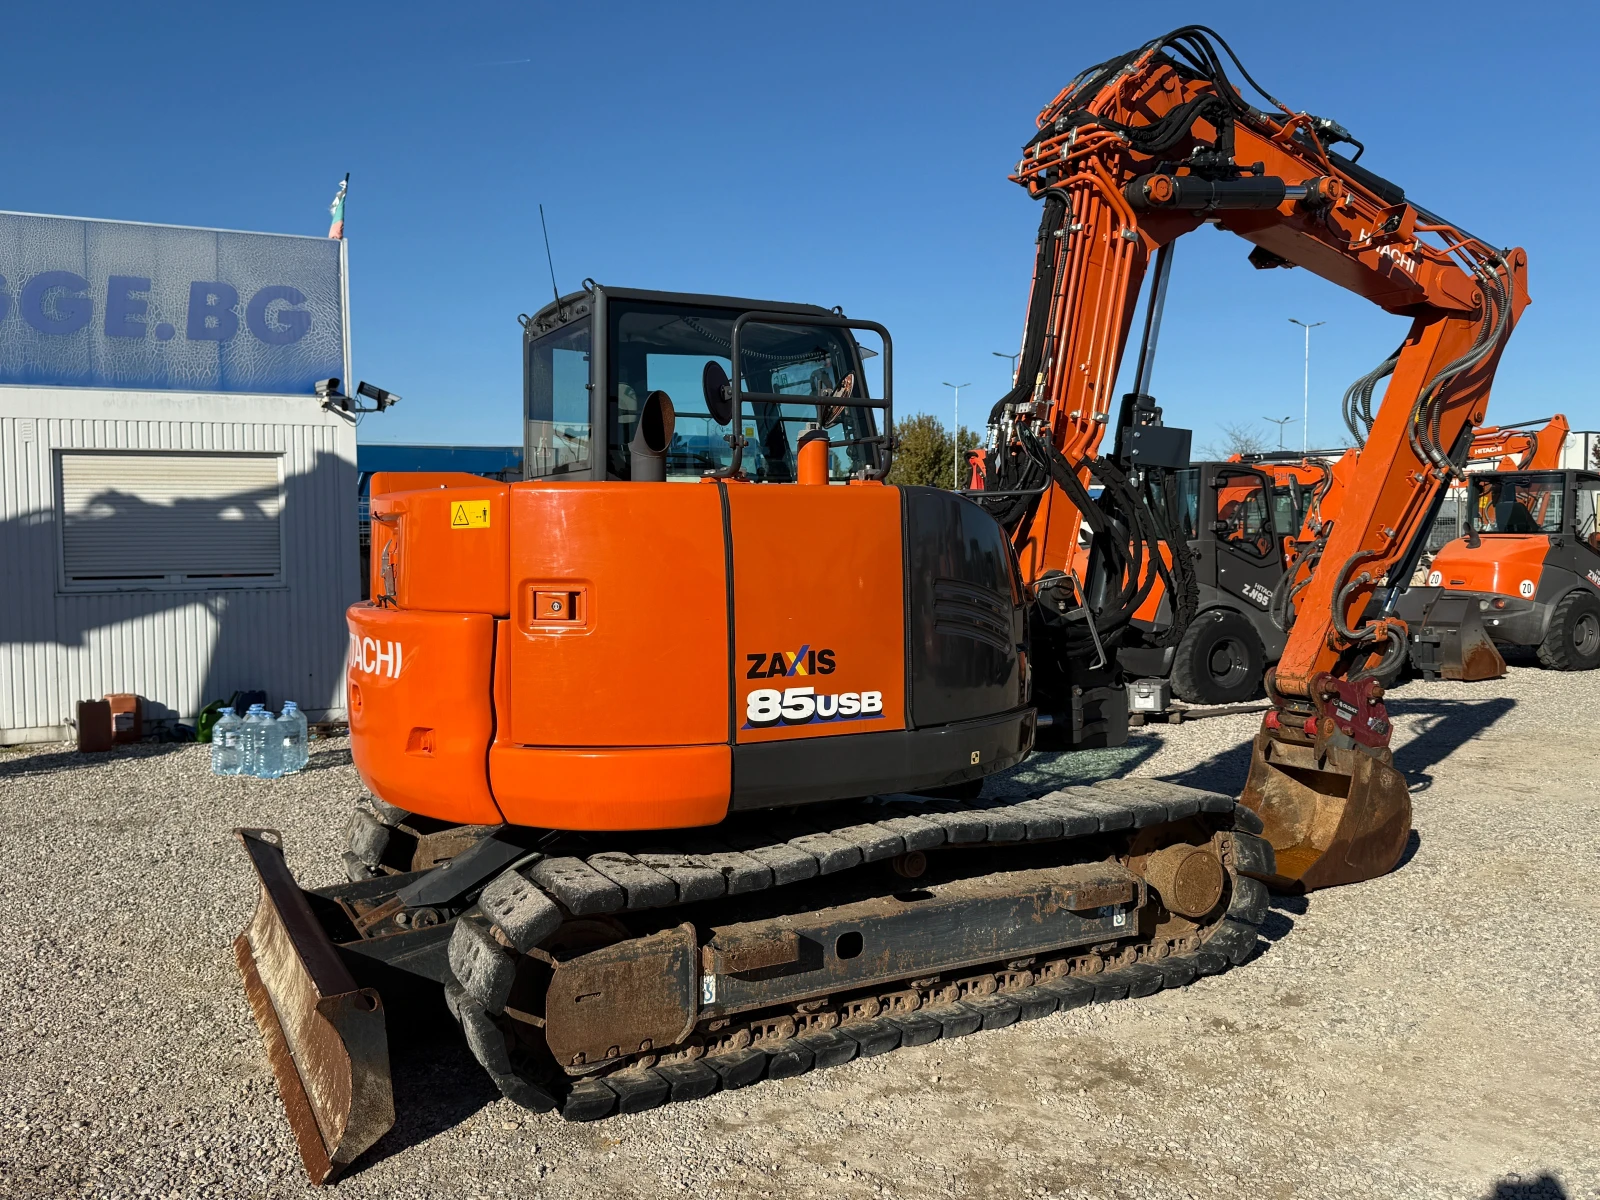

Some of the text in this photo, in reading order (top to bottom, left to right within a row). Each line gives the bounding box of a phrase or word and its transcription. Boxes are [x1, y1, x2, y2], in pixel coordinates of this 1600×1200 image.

[1359, 228, 1416, 274] HACHI
[0, 270, 313, 346] GE.BG
[1474, 446, 1503, 455] HITACHI
[1430, 574, 1440, 585] 20
[1522, 583, 1532, 594] 20
[746, 644, 837, 680] ZAXIS
